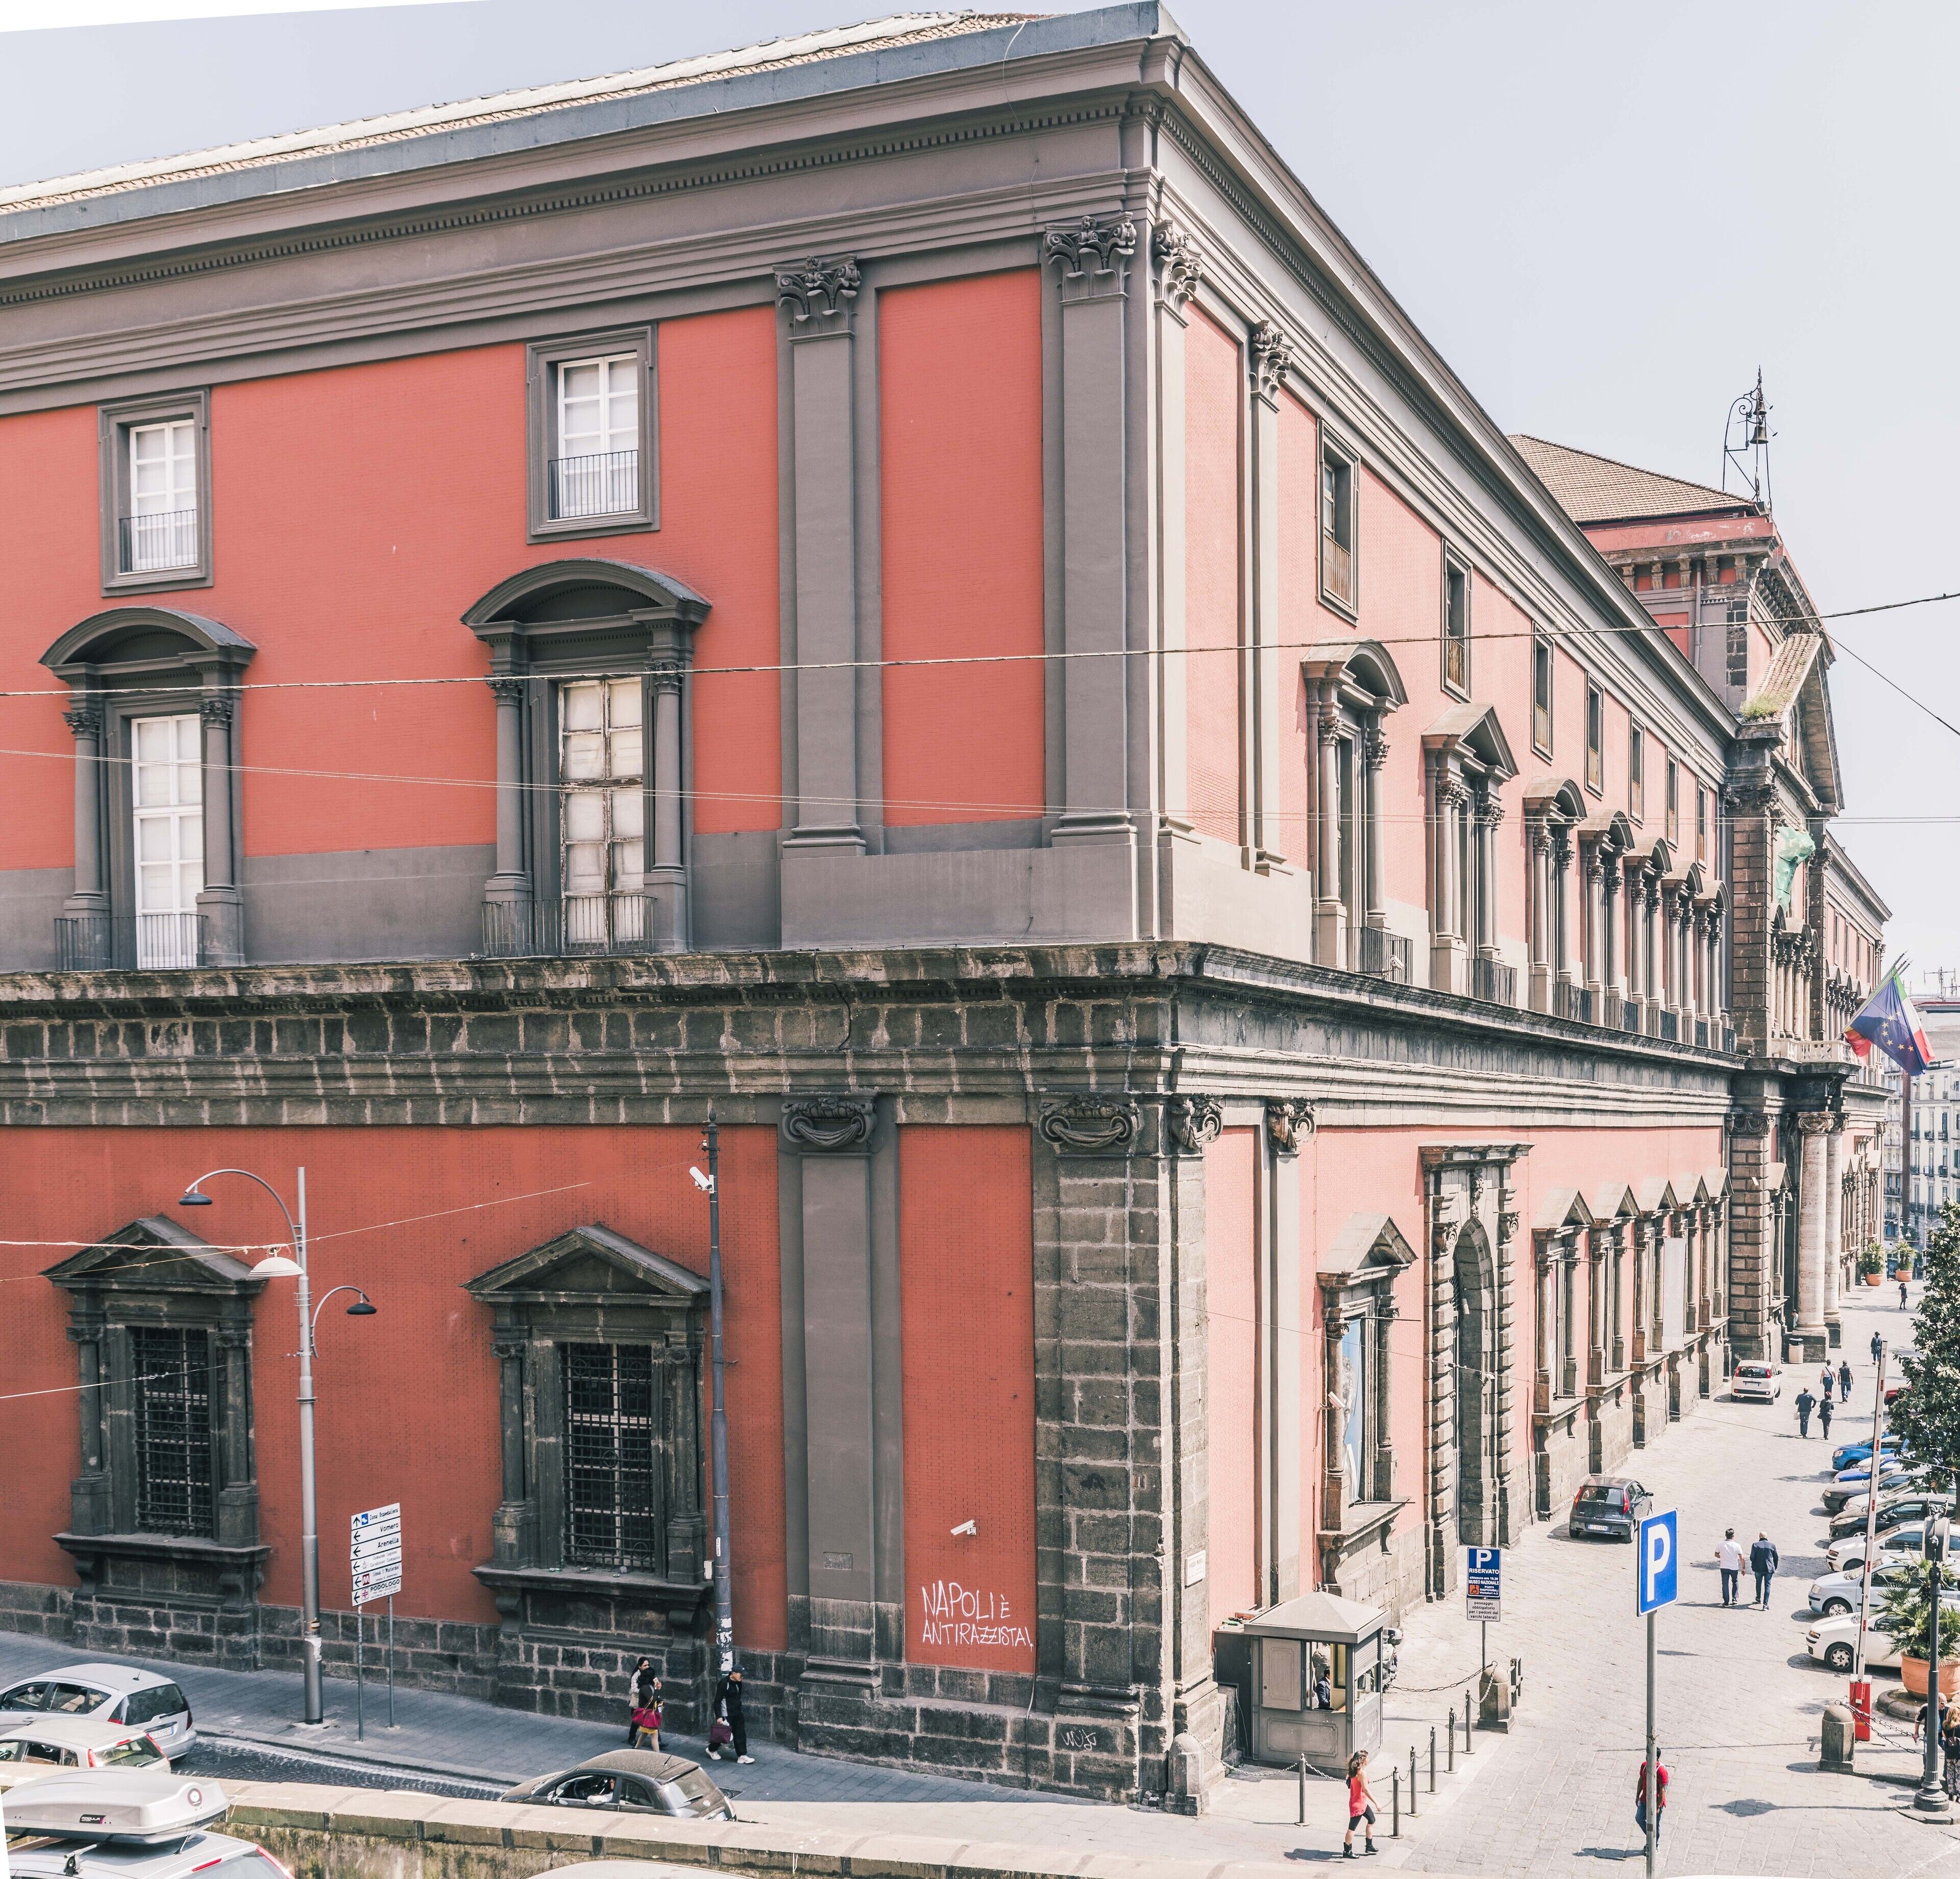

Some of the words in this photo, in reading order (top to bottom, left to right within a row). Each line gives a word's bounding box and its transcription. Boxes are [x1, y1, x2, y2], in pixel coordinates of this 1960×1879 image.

[380, 1522, 399, 1532] Vomero
[378, 1537, 399, 1548] Arenella
[1476, 1549, 1492, 1568] P
[1647, 1523, 1671, 1602] P
[370, 1578, 400, 1592] PODOLOGO
[922, 1580, 994, 1622] NAPOLI
[1000, 1594, 1011, 1618] È
[922, 1619, 1034, 1649] ANTIRAZZISTA!
